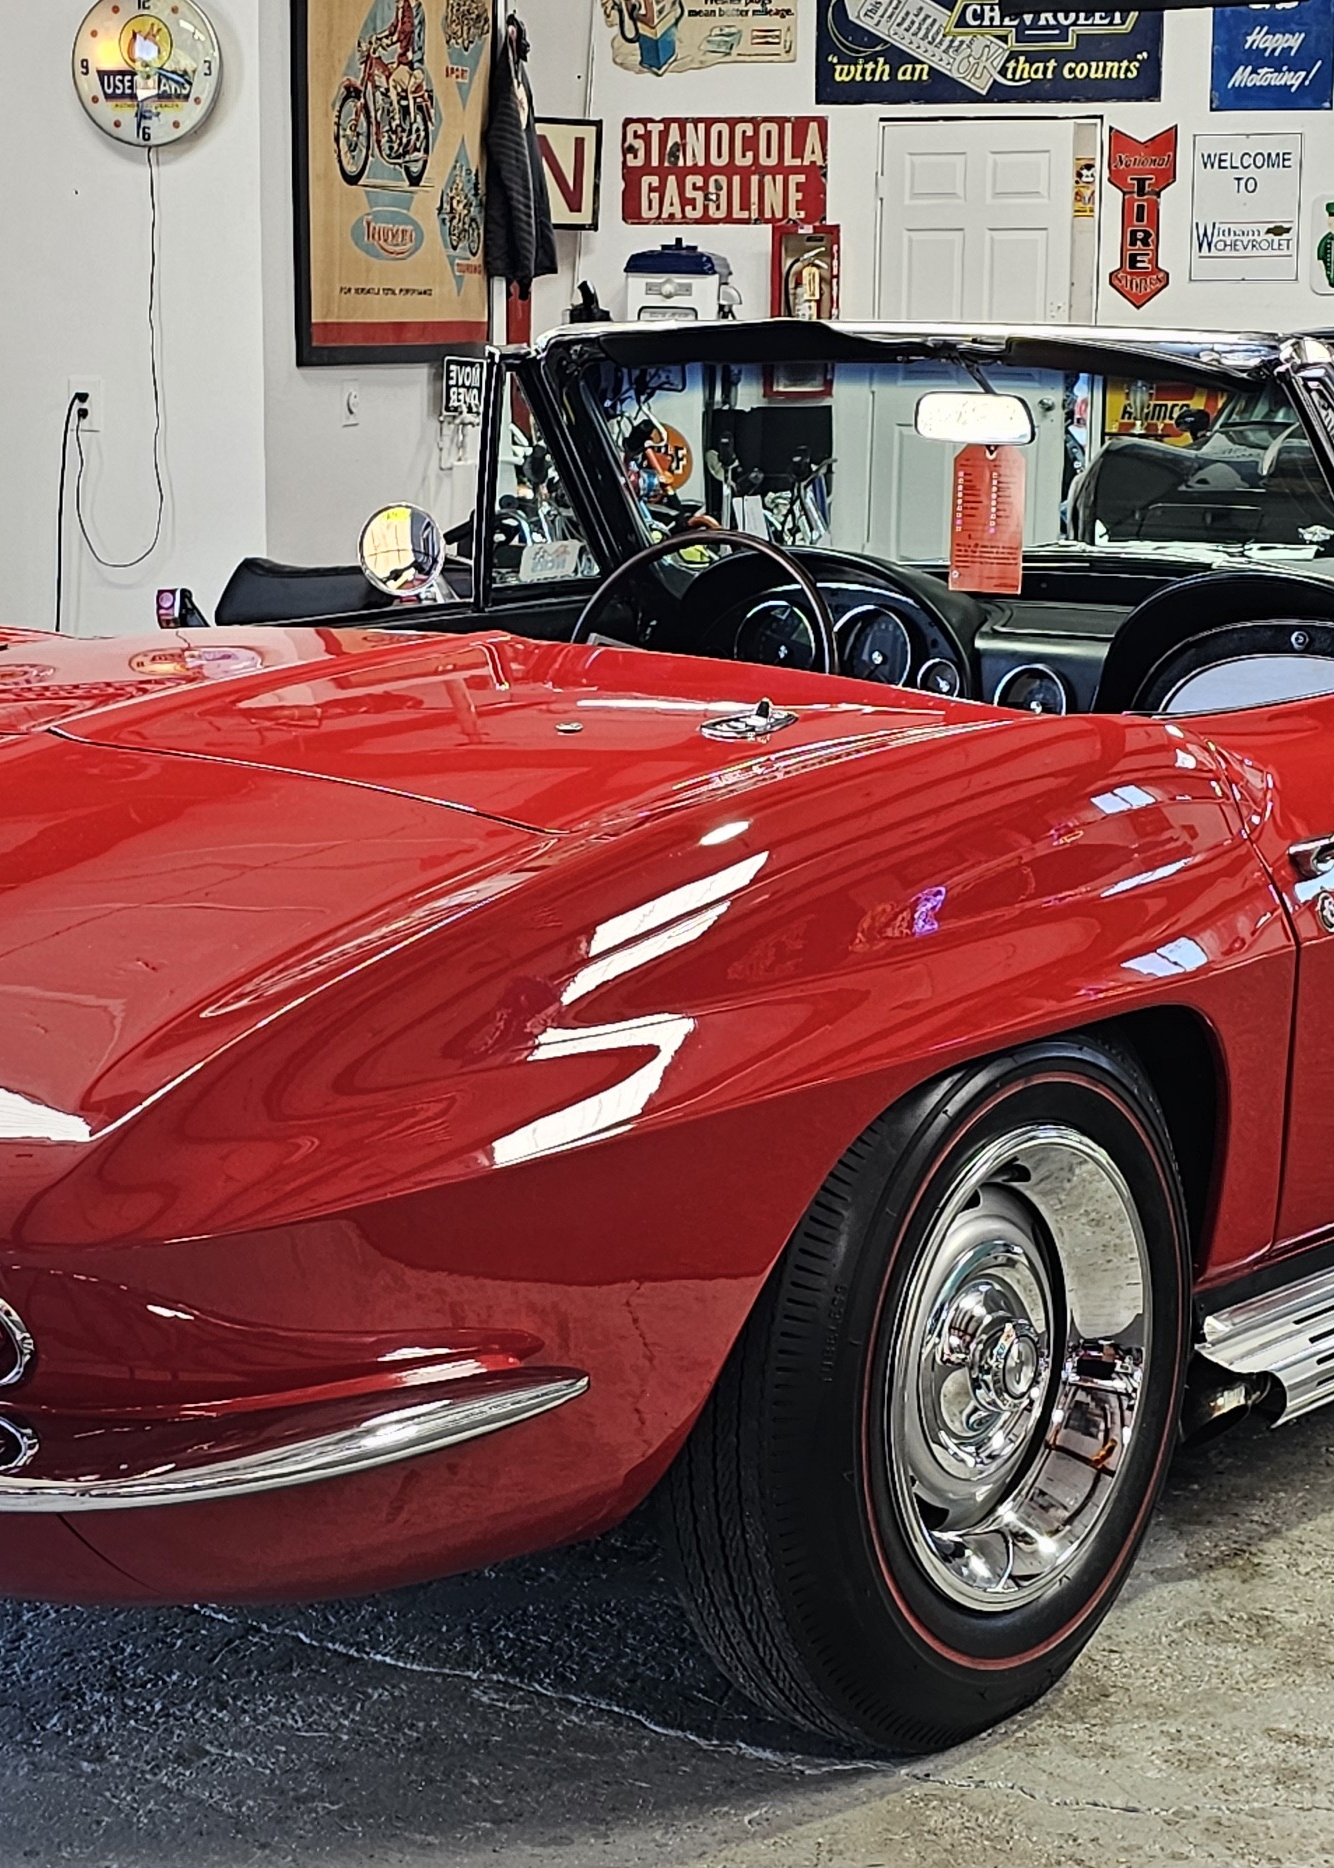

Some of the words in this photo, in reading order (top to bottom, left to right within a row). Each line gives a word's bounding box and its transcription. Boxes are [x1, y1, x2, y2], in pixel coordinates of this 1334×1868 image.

[1244, 25, 1305, 57] Happy
[80, 58, 90, 76] 9
[203, 60, 213, 77] 3
[897, 63, 930, 81] an
[1005, 56, 1057, 80] that
[1227, 60, 1322, 93] Motoring!
[104, 74, 138, 95] USE
[141, 125, 151, 142] 6
[626, 121, 824, 167] STANOCOLA
[1113, 154, 1172, 170] National
[1201, 151, 1293, 170] WELCOME
[1233, 176, 1259, 194] TO
[640, 174, 807, 219] GASOLINE
[1127, 176, 1155, 271] TIRE
[1213, 238, 1293, 252] CHEVROLET
